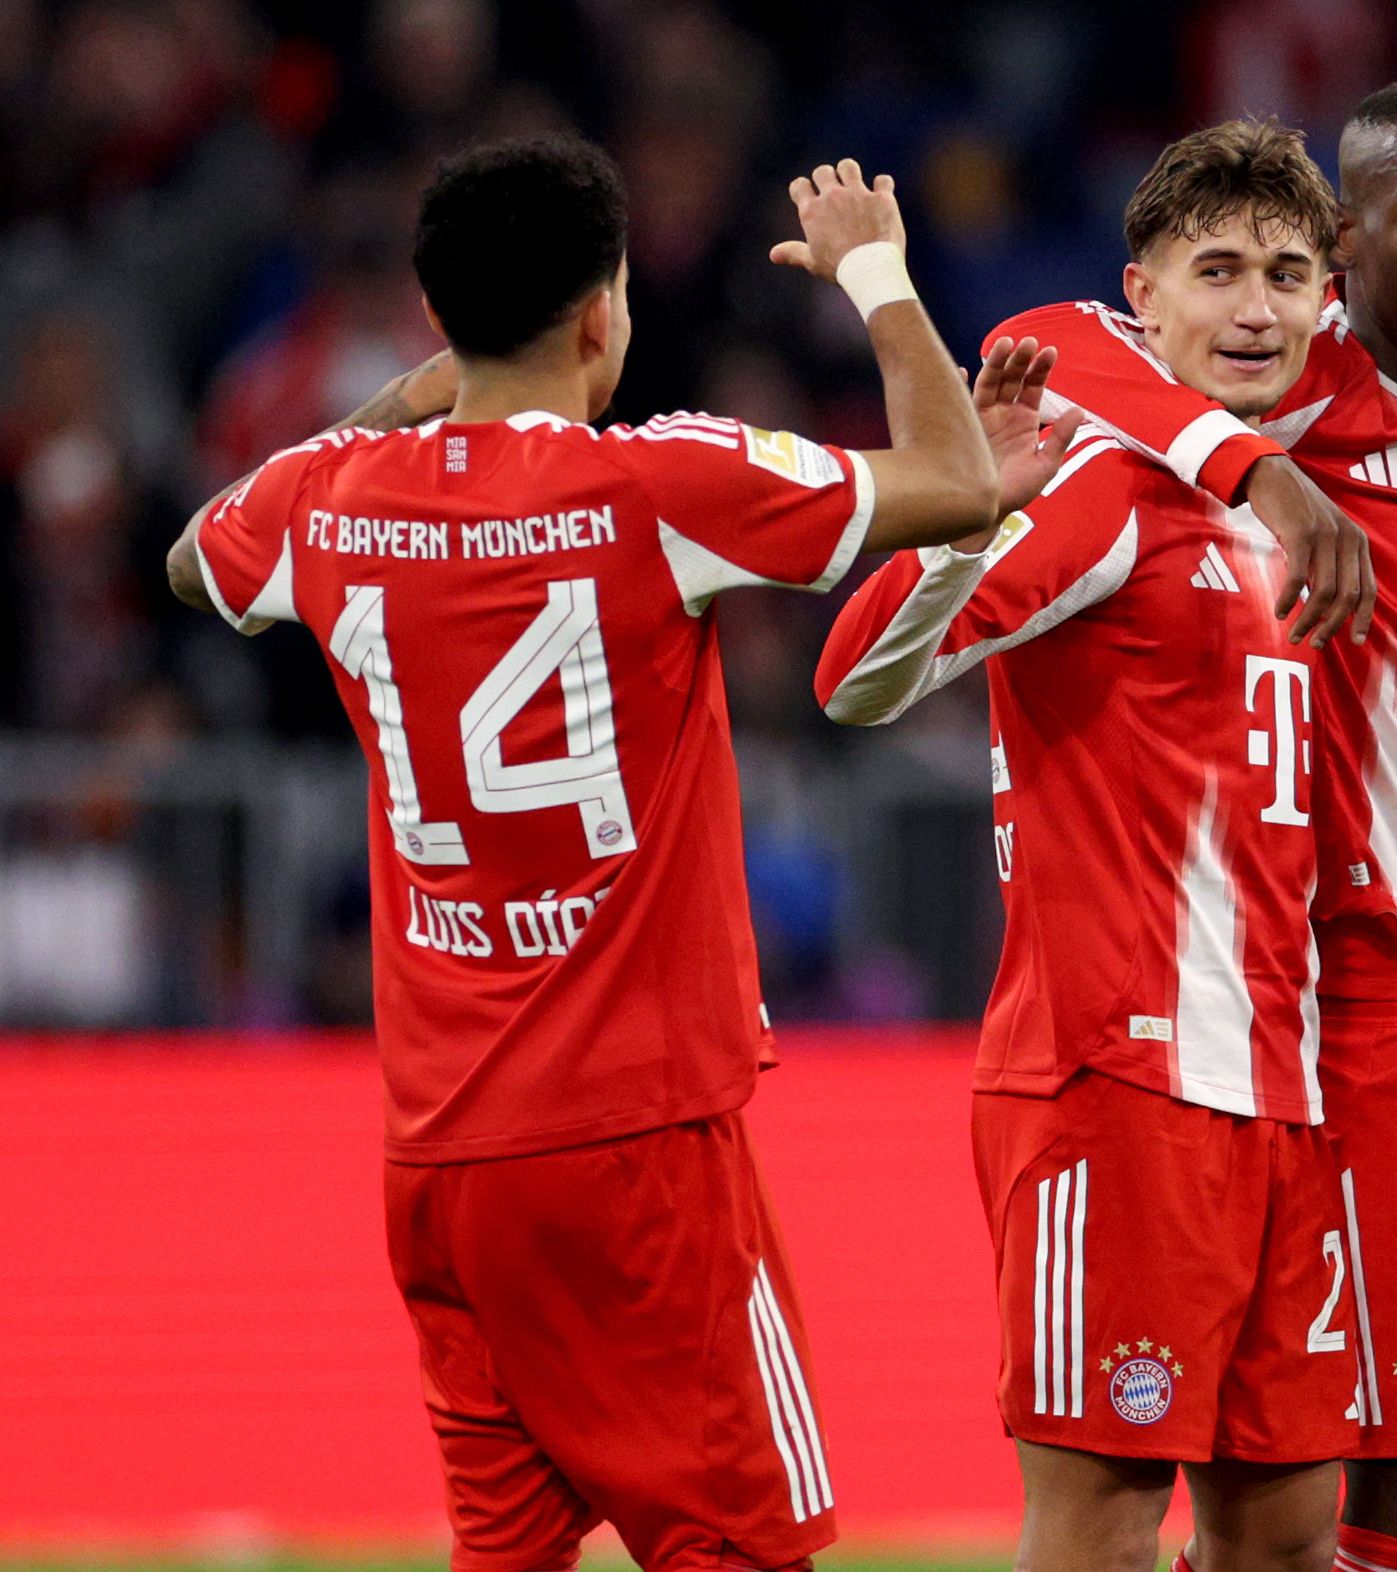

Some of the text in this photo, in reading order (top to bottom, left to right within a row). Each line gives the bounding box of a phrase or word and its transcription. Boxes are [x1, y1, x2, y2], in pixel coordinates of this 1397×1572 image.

[446, 436, 467, 449] MIA
[446, 449, 467, 461] SAN
[446, 461, 467, 473] MIA
[306, 504, 616, 560] FC BAYERN MÜNCHEN
[328, 577, 638, 866] 14
[405, 885, 612, 958] LUIS DÍA
[1307, 1229, 1346, 1354] 2
[1116, 1363, 1168, 1389] FC BAYERN
